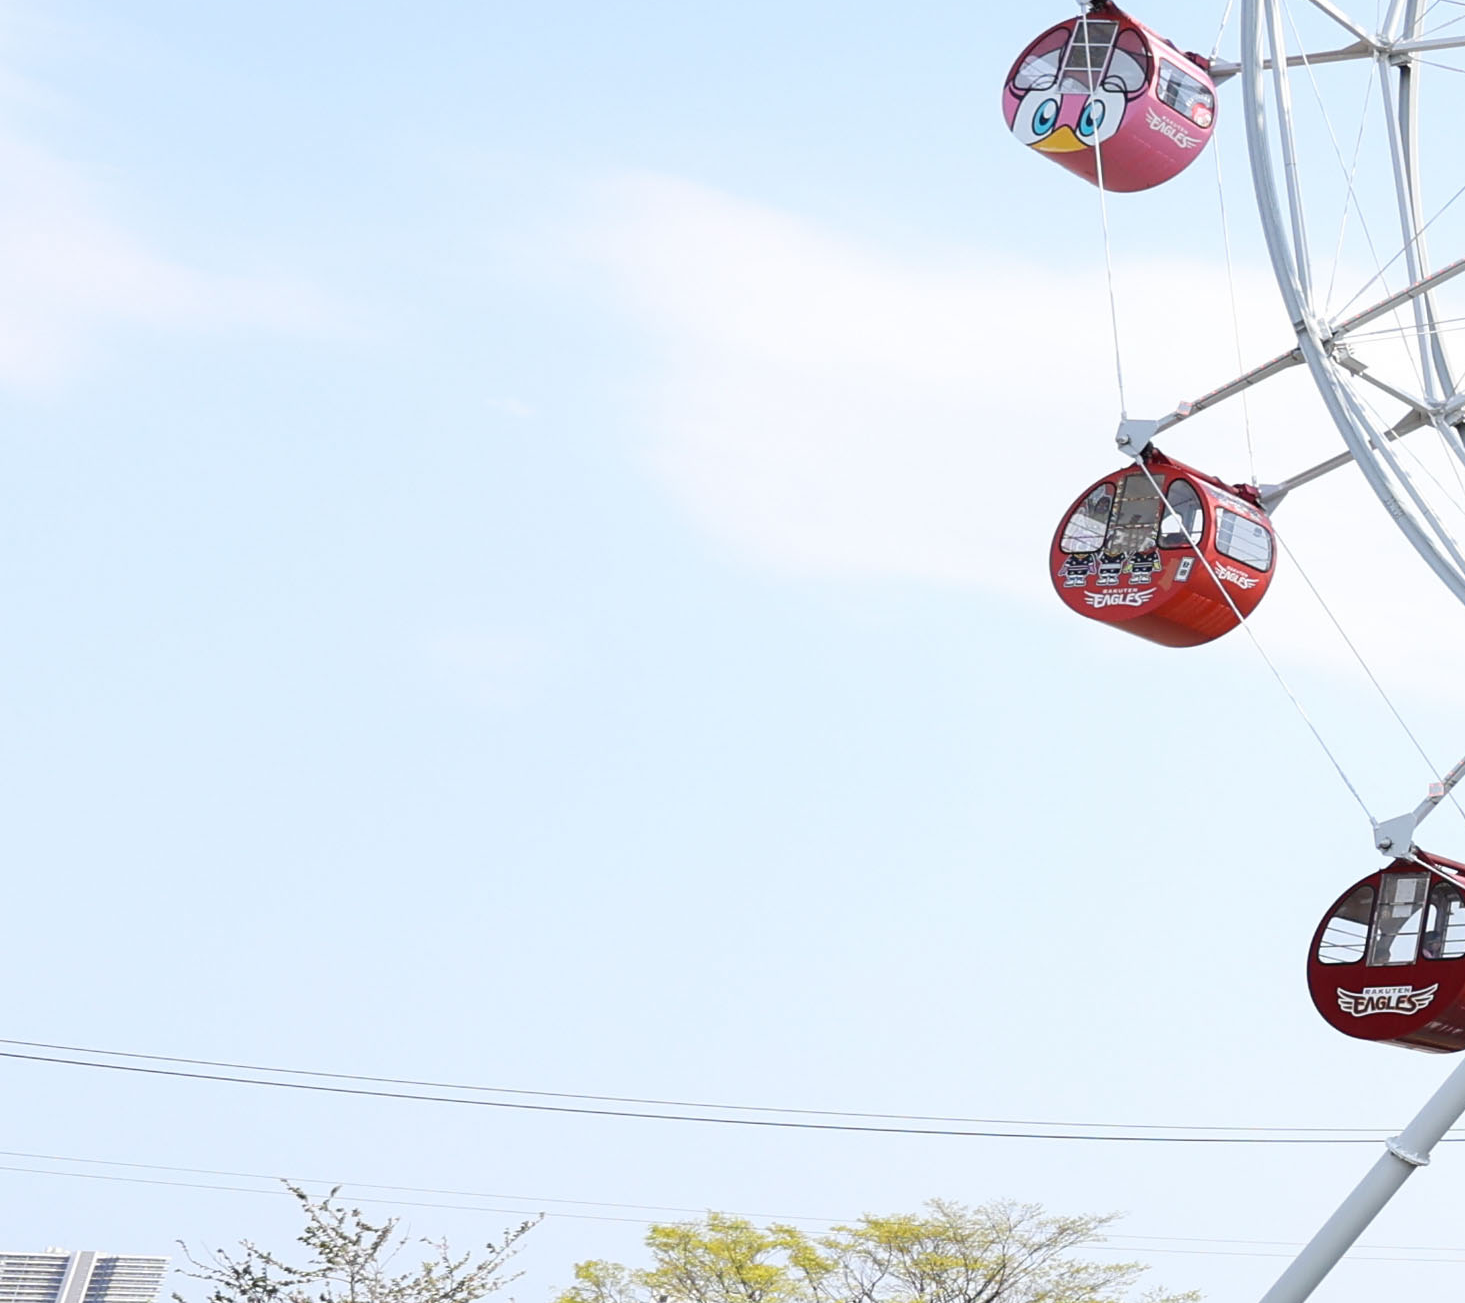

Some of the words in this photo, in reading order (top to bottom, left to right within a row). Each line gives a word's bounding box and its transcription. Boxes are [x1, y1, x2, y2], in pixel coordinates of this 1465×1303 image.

[1150, 117, 1189, 148] EAGLES
[1218, 571, 1251, 589] EAGLES
[1093, 593, 1144, 608] EAGLES
[1365, 987, 1411, 995] RAKUTEN
[1353, 995, 1418, 1015] EAGLES
